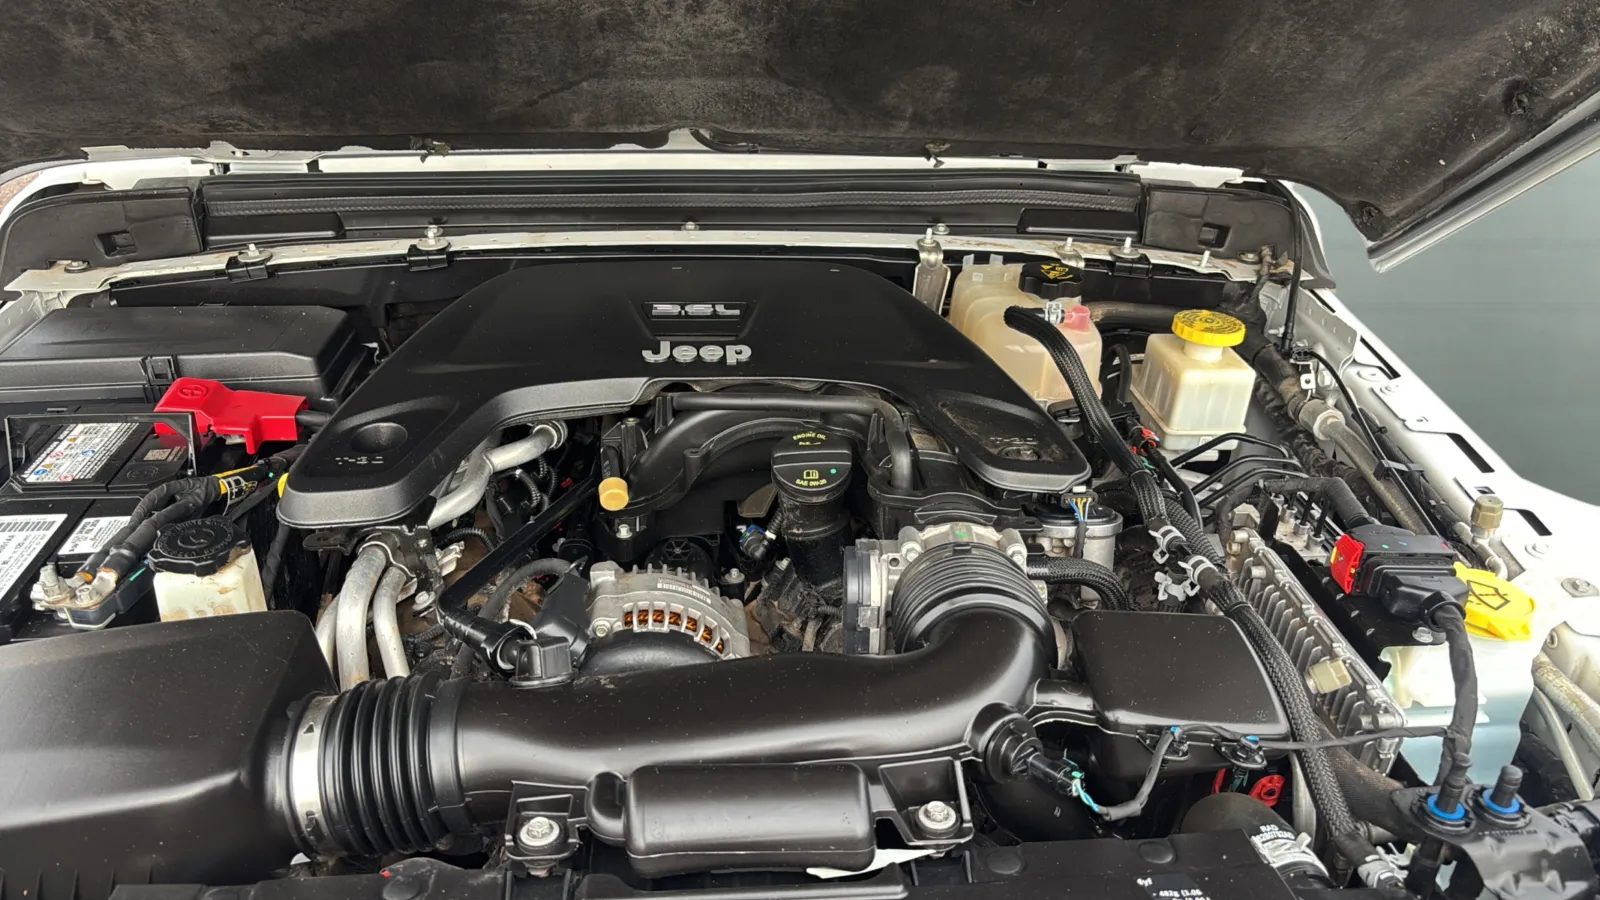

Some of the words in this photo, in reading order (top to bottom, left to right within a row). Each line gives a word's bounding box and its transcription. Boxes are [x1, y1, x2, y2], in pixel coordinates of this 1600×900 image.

[641, 341, 752, 365] Jeep
[792, 432, 816, 440] ENGINE
[1259, 824, 1279, 833] RAD
